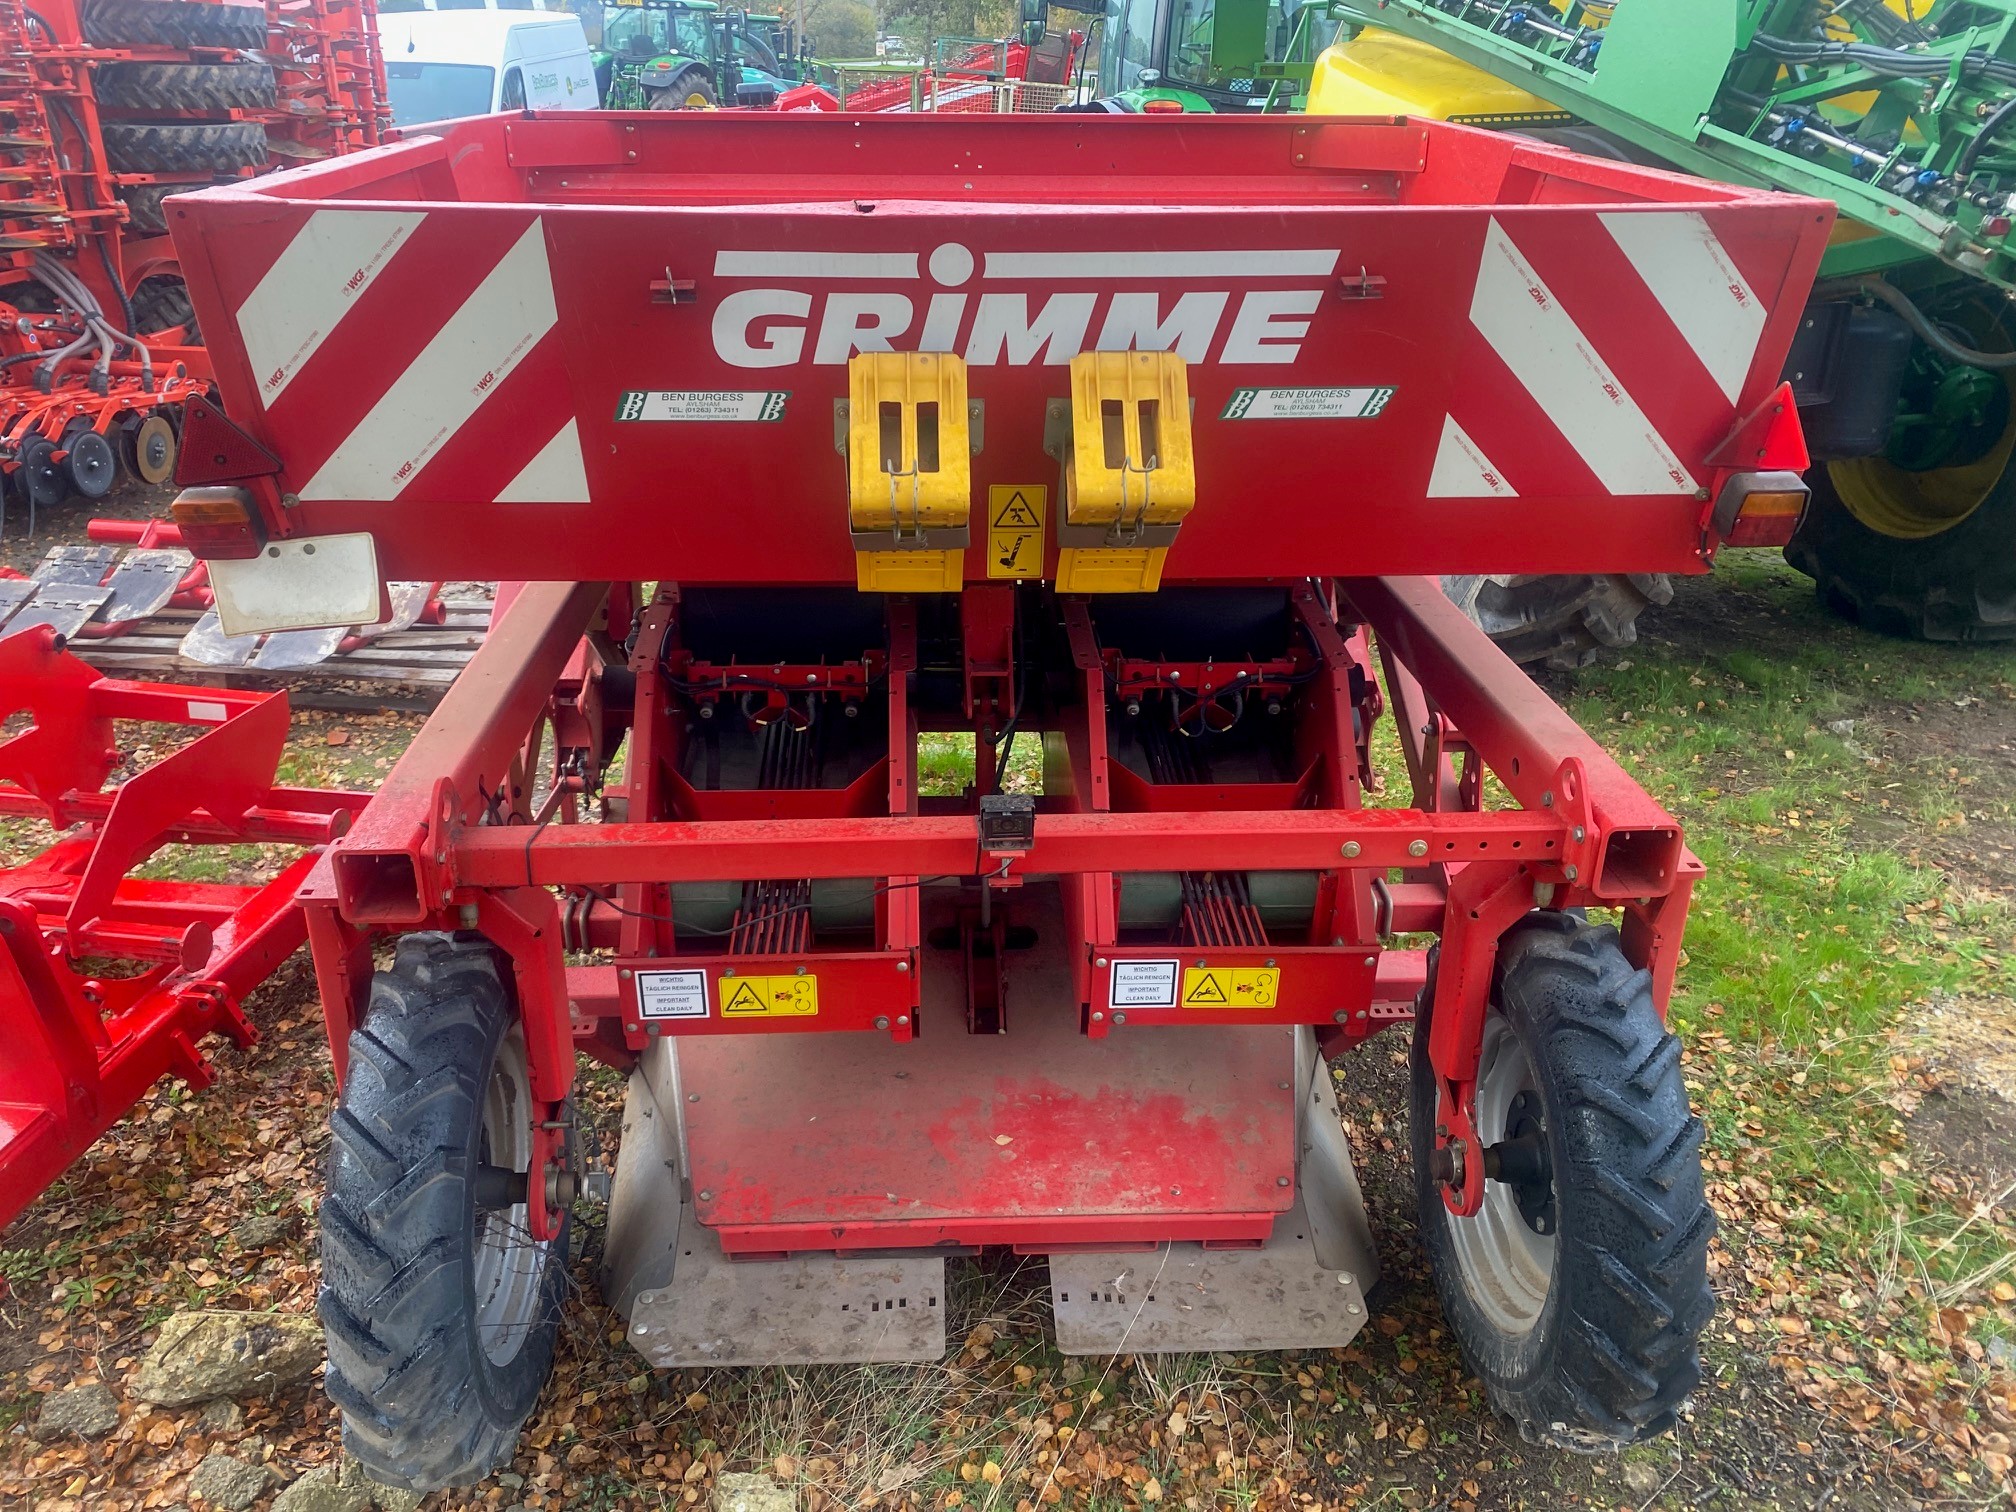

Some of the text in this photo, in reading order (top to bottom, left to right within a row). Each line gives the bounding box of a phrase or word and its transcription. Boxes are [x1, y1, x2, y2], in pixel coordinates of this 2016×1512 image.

[347, 268, 365, 290] WGF
[1528, 287, 1546, 305] WGF
[1728, 284, 1746, 303] WGF
[268, 367, 284, 387] WGF
[477, 370, 494, 390] WGF
[661, 393, 744, 401] BEN BURGESS
[1270, 389, 1351, 399] BEN BURGESS
[1602, 383, 1619, 400] WGF
[396, 460, 412, 479] WGF
[1668, 470, 1684, 485] WGF
[1482, 472, 1499, 488] WGF
